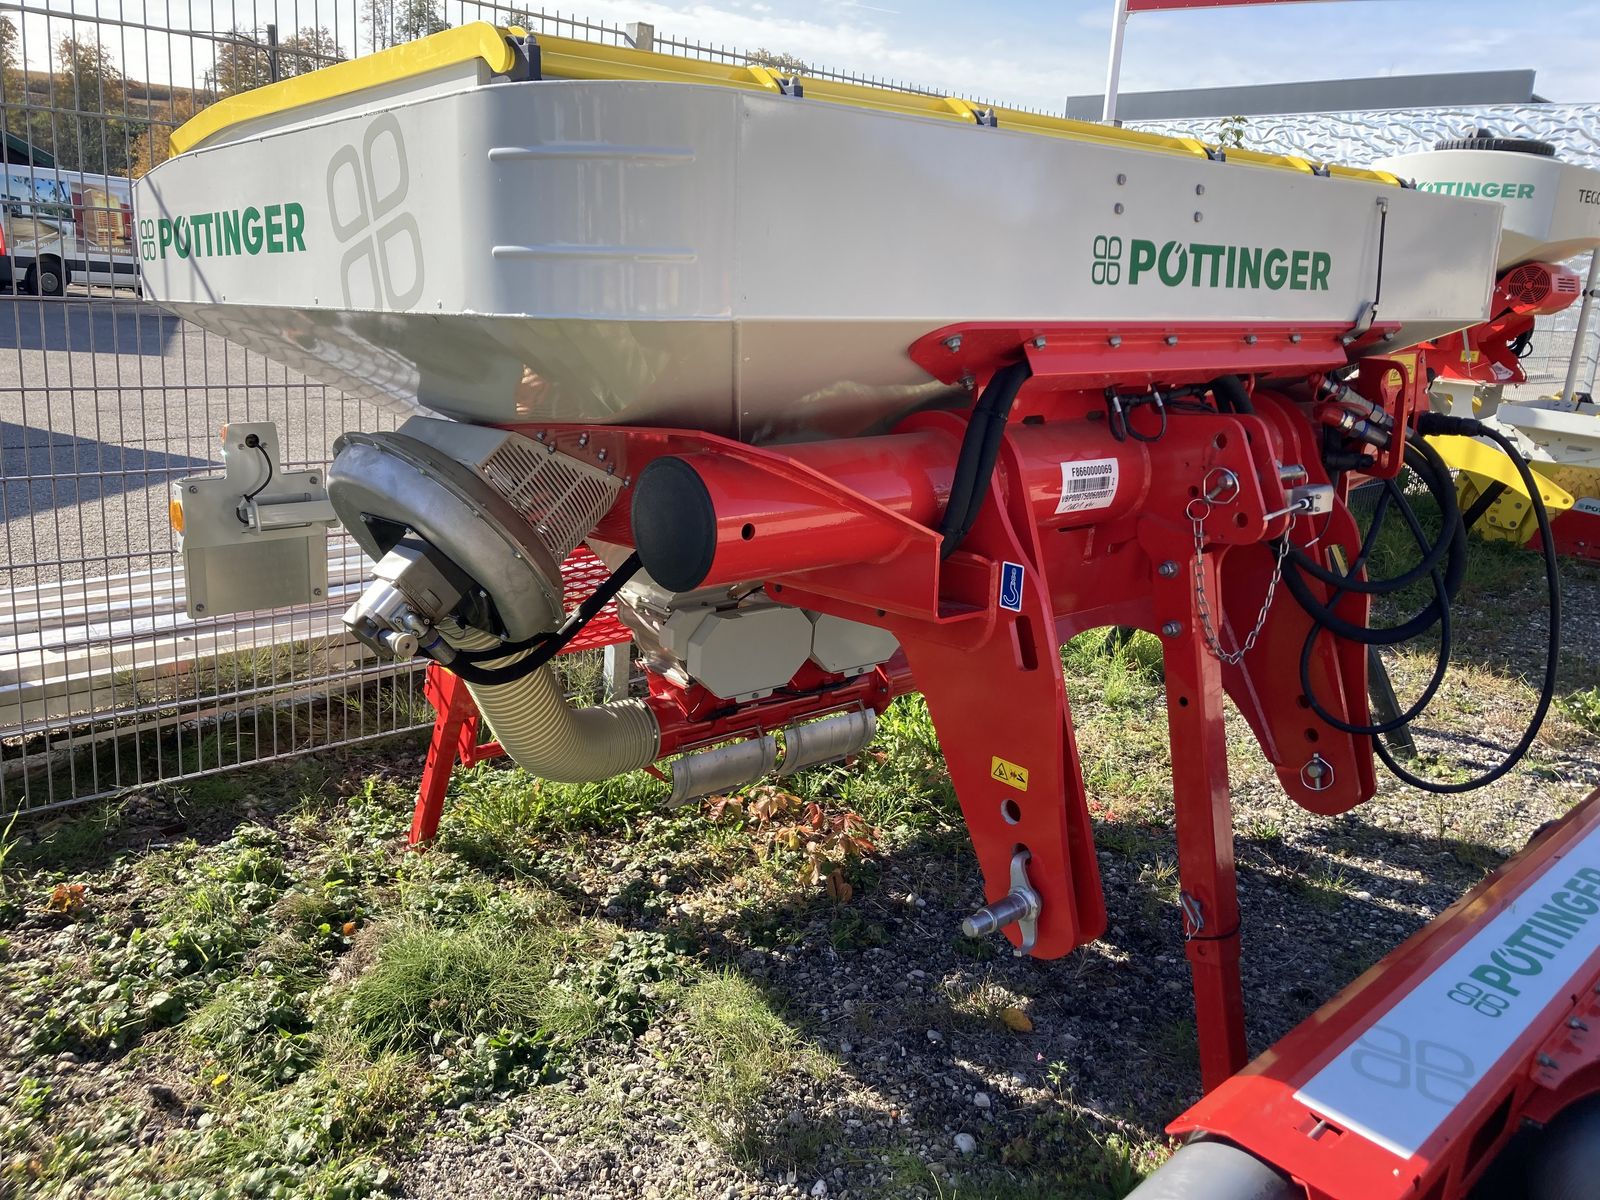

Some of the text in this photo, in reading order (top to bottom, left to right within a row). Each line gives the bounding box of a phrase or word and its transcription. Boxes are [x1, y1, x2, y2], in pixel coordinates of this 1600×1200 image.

[1415, 181, 1536, 199] ÖTTINGER
[157, 202, 307, 260] PÖTTINGER
[1128, 238, 1332, 291] PÖTTINGER
